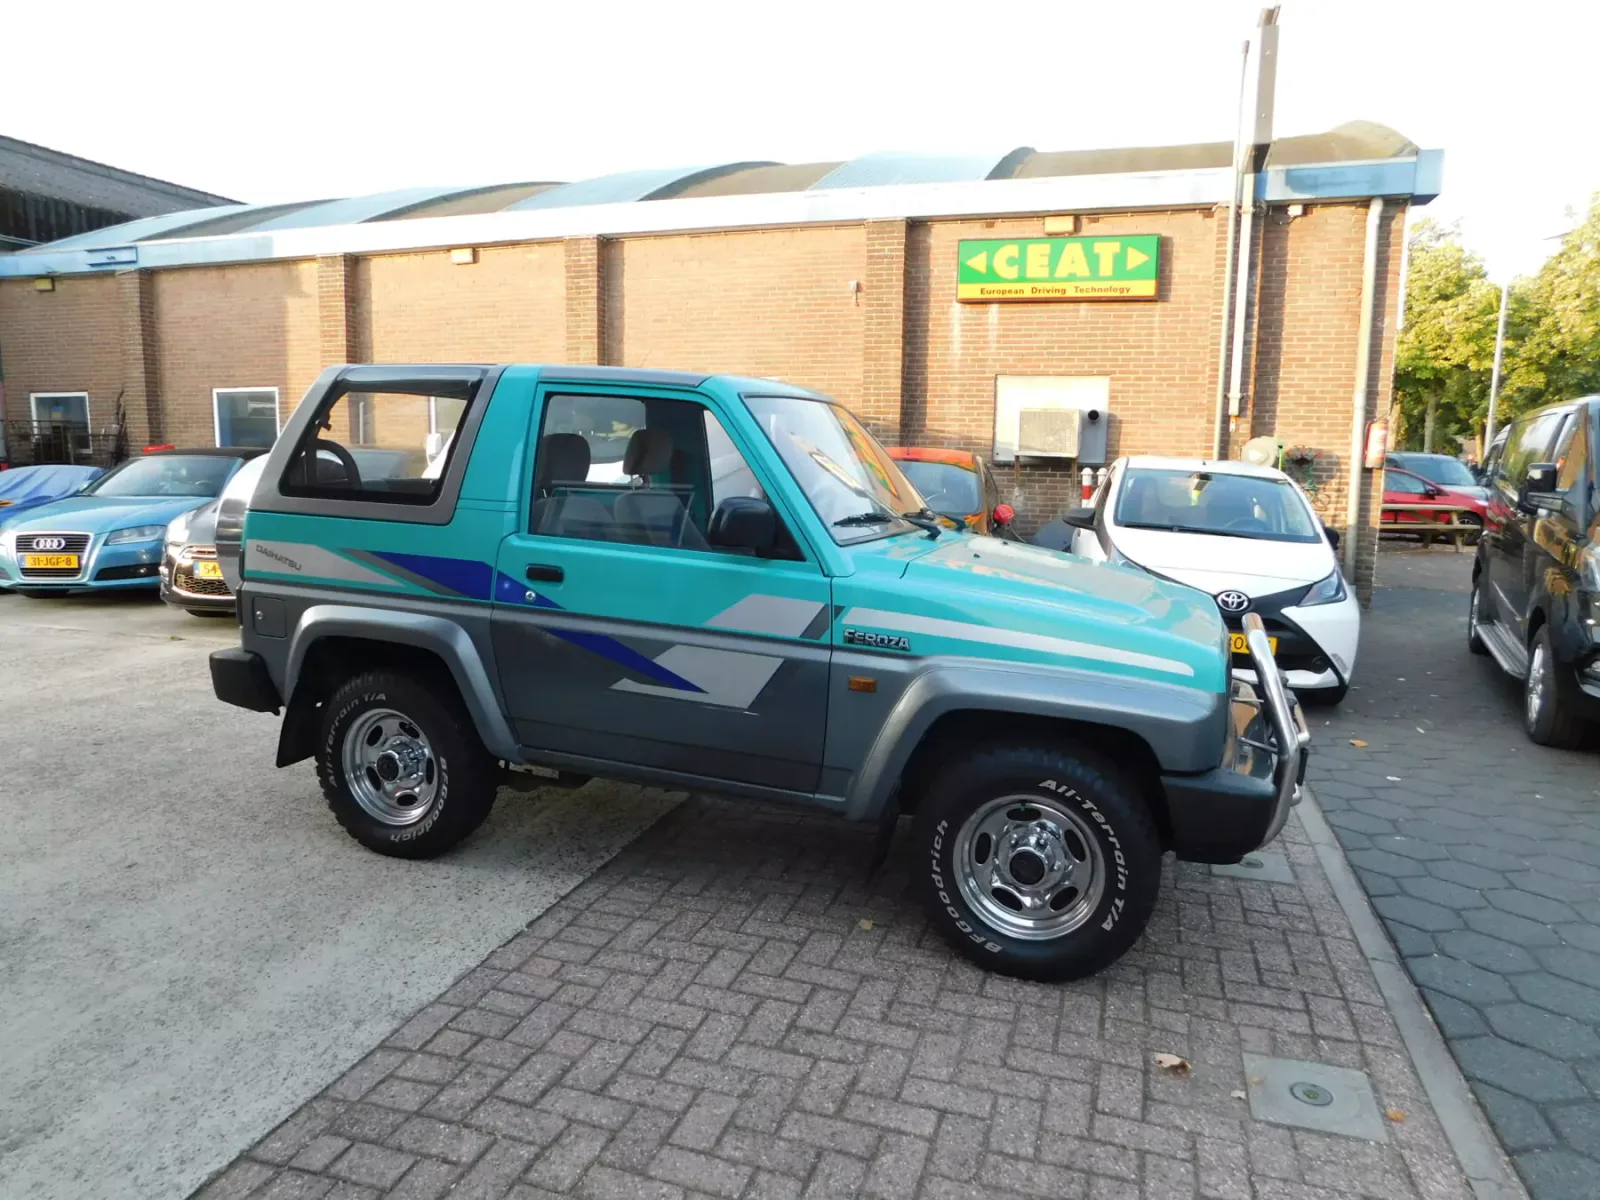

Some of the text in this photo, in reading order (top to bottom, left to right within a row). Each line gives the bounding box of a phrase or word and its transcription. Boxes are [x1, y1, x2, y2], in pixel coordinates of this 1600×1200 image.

[992, 241, 1122, 280] CEAT
[980, 285, 1131, 296] European Driving Technology
[30, 556, 72, 567] 31-JGF-8
[255, 544, 302, 571] DAIHATSU
[843, 628, 911, 651] FEROZA
[325, 698, 360, 788] All-Terrain
[389, 755, 449, 843] BFGoodrich
[1037, 779, 1129, 932] All-Terrain T/A
[930, 819, 1004, 954] BFGoodrich
